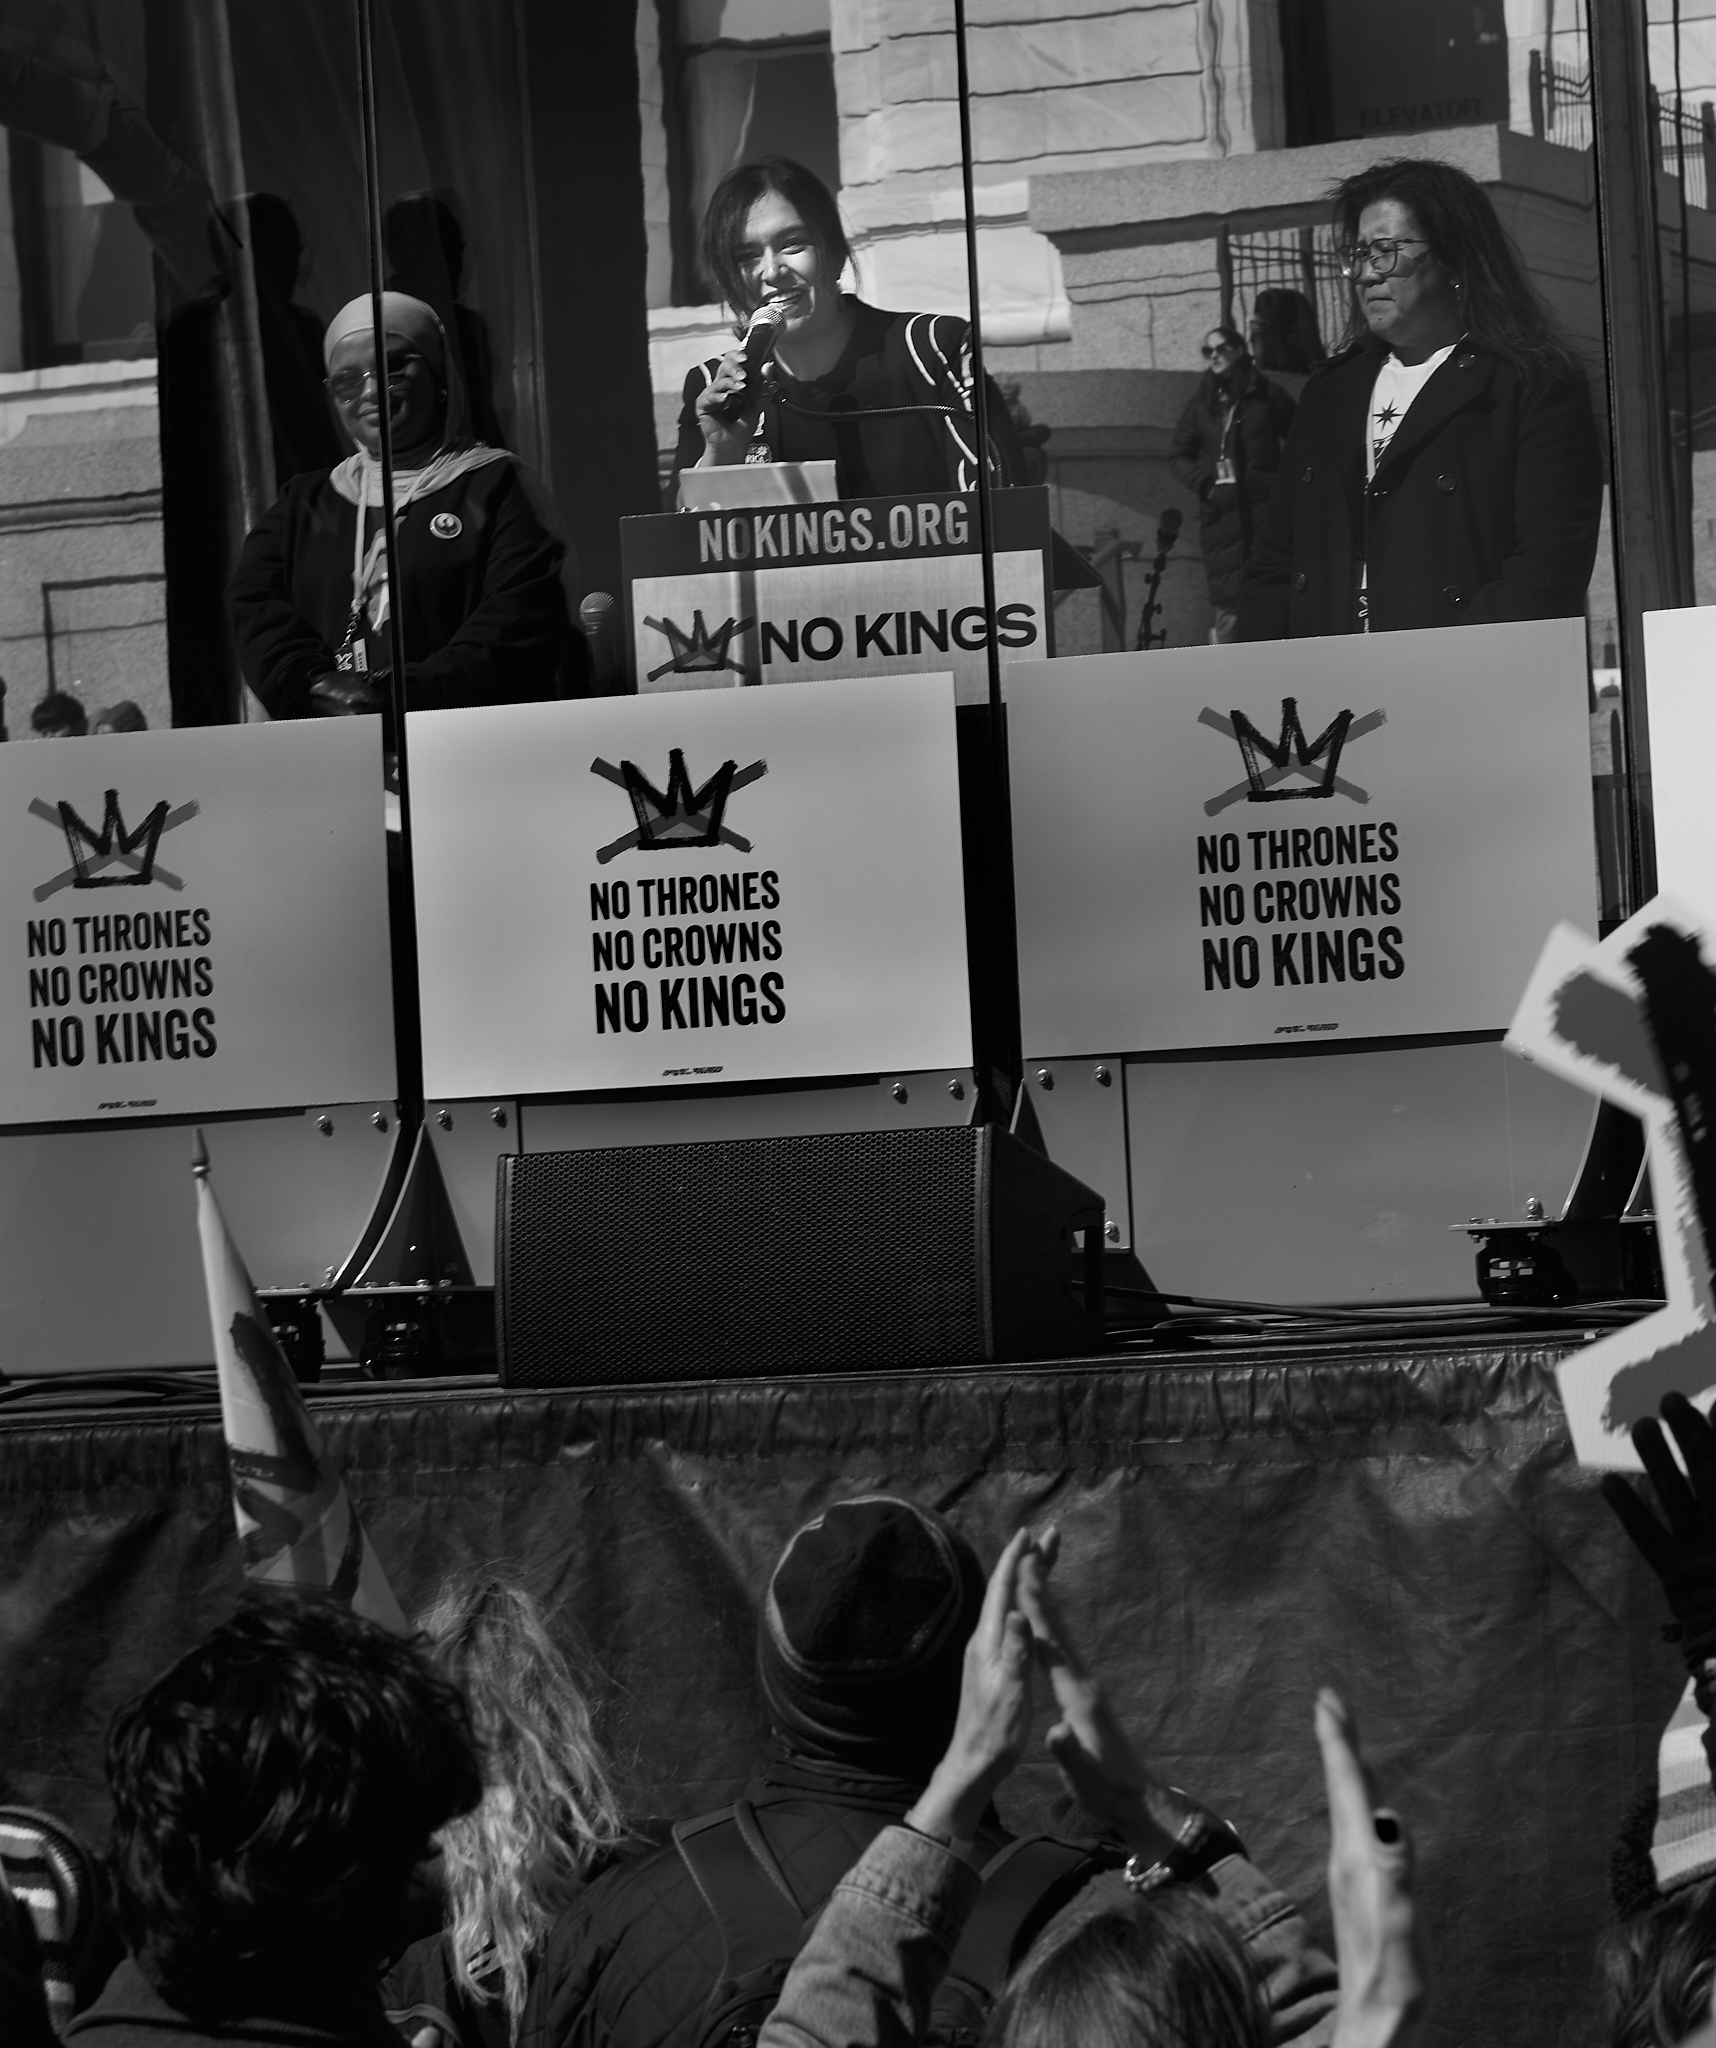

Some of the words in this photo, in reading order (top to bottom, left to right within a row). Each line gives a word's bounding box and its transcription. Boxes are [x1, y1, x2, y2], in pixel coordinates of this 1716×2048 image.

[1359, 97, 1482, 127] ELEVATOR
[699, 500, 970, 563] NOKINGS.ORG
[760, 615, 844, 665] NO
[855, 603, 1038, 659] KINGS
[1197, 833, 1240, 875] NO
[1247, 822, 1399, 871] THRONES
[590, 880, 631, 921] NO
[637, 870, 781, 918] THRONES
[1200, 884, 1245, 927] NO
[1253, 873, 1401, 924] CROWNS
[27, 917, 67, 958] NO
[72, 907, 212, 955] THRONES
[592, 929, 635, 972] NO
[642, 919, 783, 970] CROWNS
[1202, 935, 1260, 991] NO
[1272, 926, 1405, 987] KINGS
[29, 965, 71, 1008] NO
[79, 956, 214, 1005] CROWNS
[595, 980, 650, 1034] NO
[660, 971, 786, 1031] KINGS
[32, 1015, 86, 1069] NO
[95, 1006, 218, 1065] KINGS
